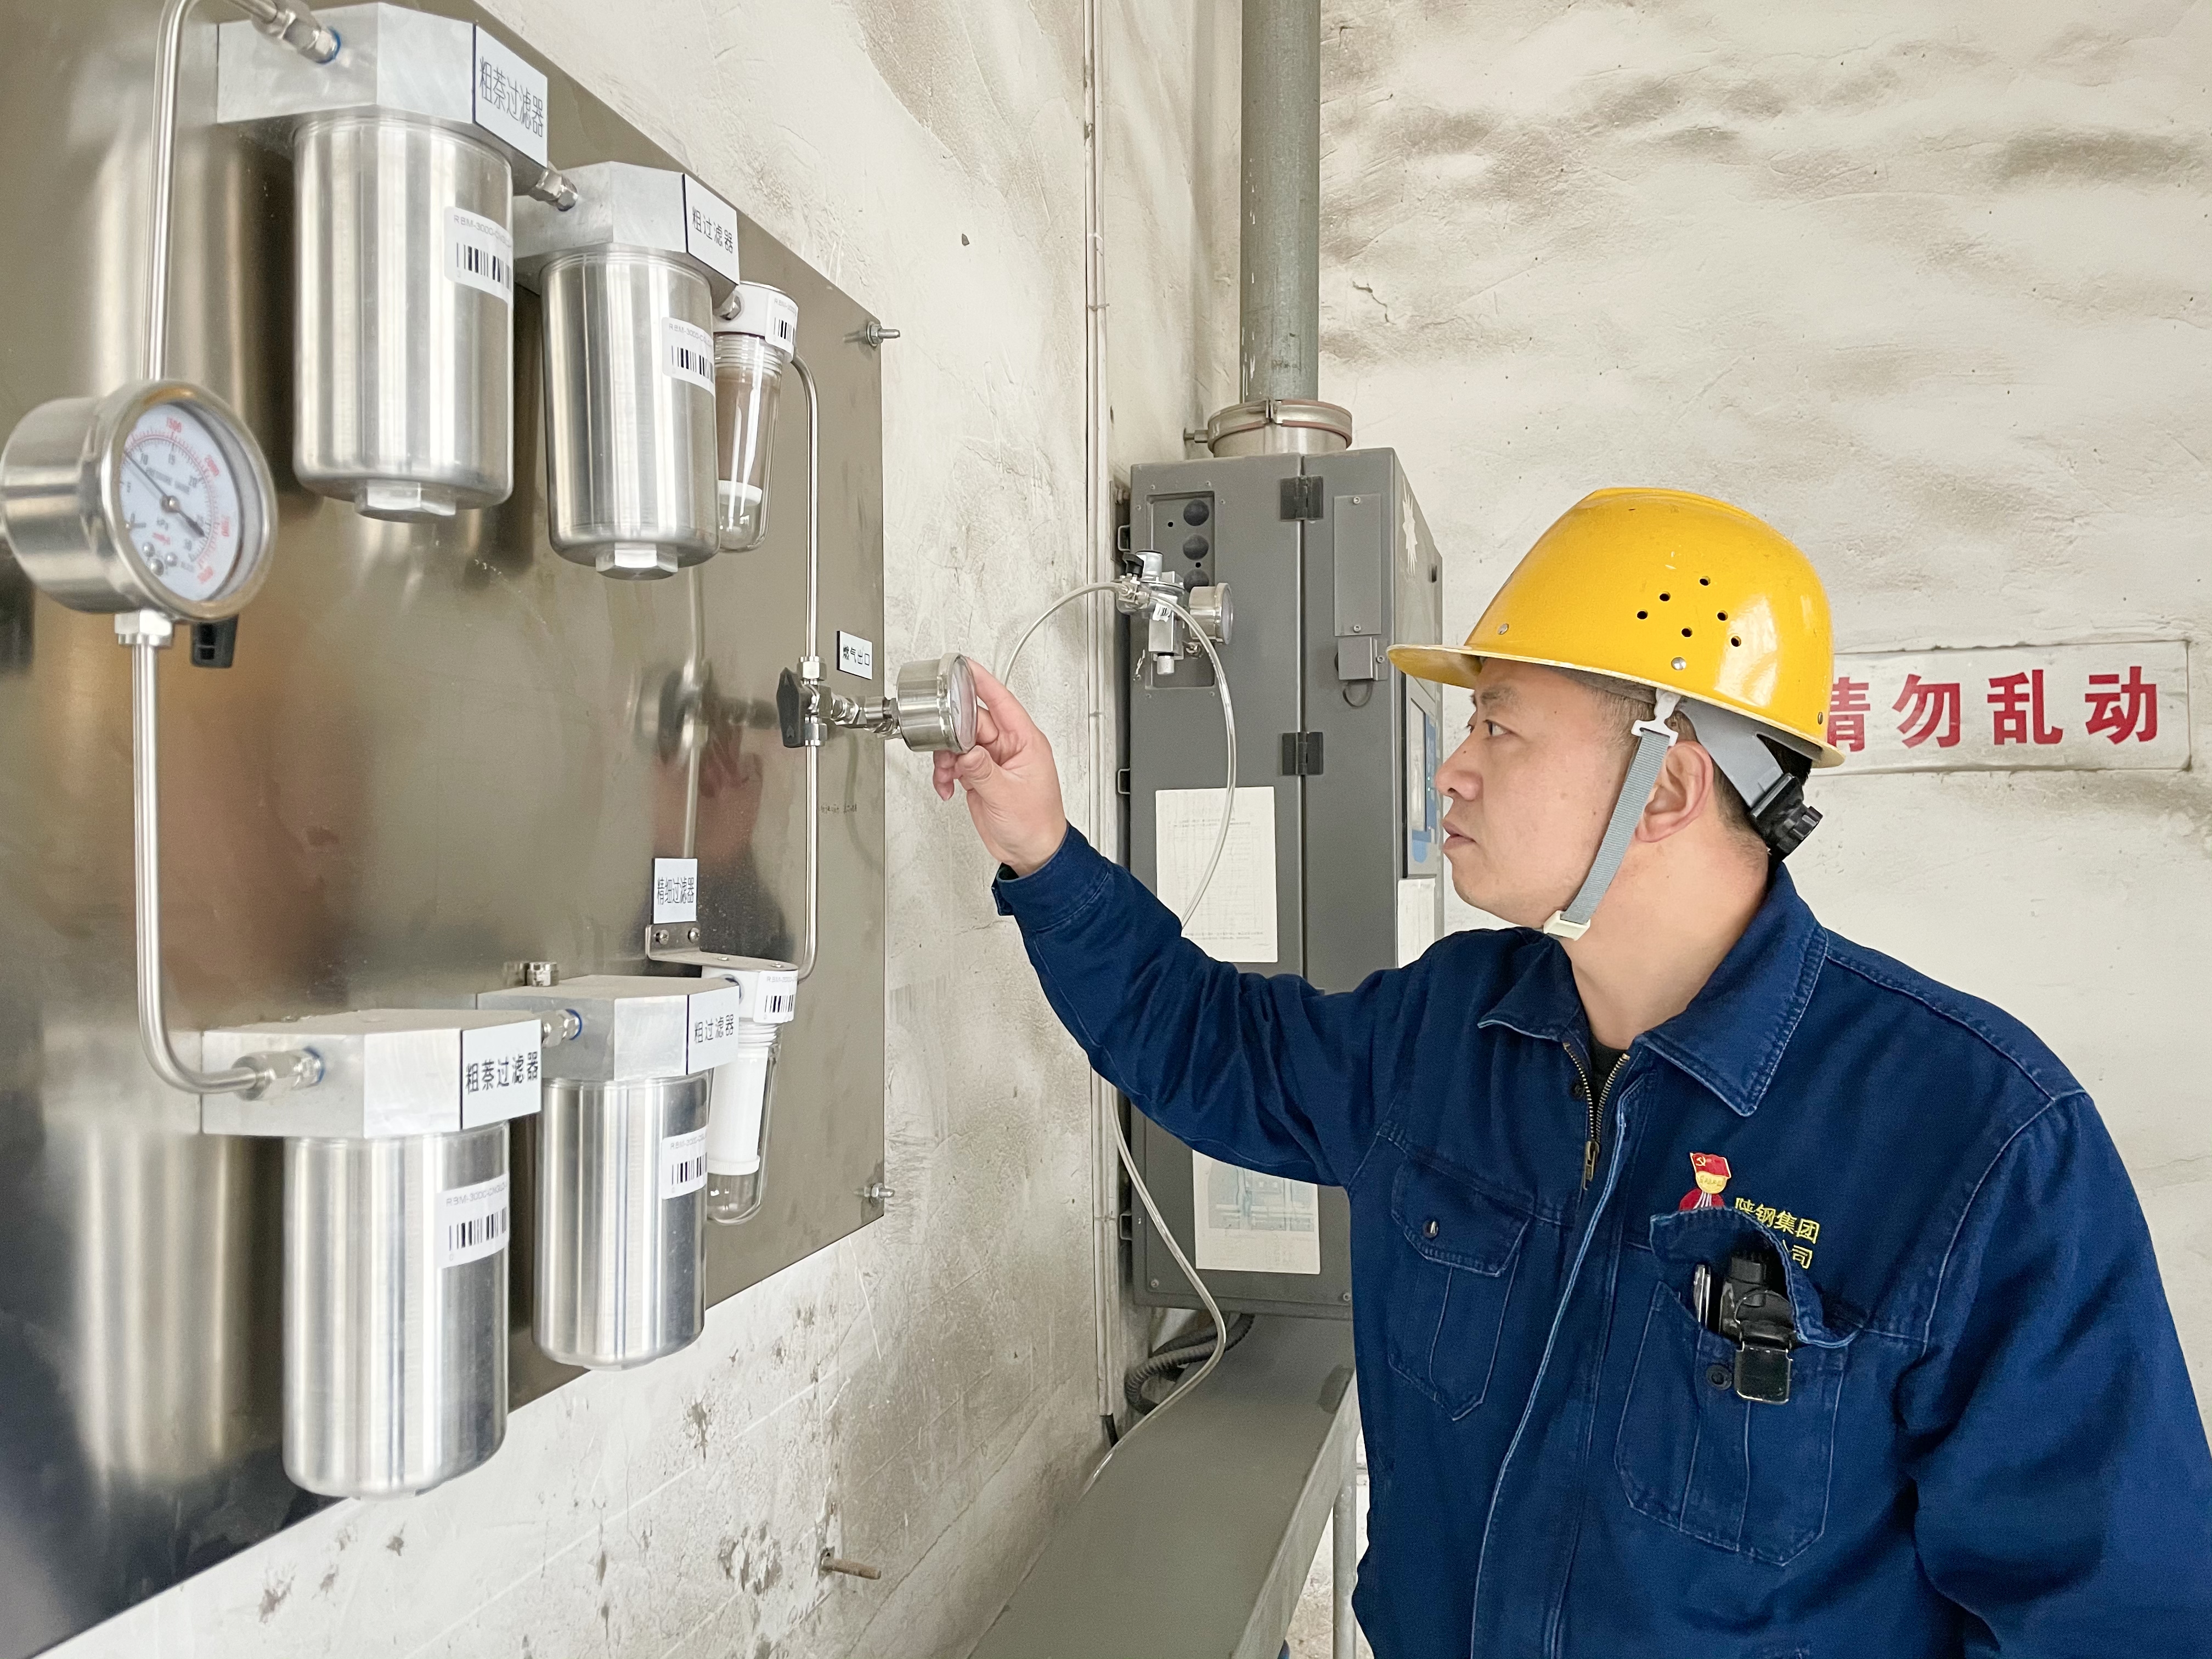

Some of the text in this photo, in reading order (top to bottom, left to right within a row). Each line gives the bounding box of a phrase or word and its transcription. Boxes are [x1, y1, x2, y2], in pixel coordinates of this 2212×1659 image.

[479, 56, 544, 137] 粗萘过滤器
[692, 206, 733, 254] 粗过滤器
[657, 876, 695, 905] 精细过滤器
[693, 1014, 734, 1044] 粗过滤器
[465, 1051, 538, 1094] 粗萘过滤器
[1735, 1197, 1821, 1244] 陕钢集团
